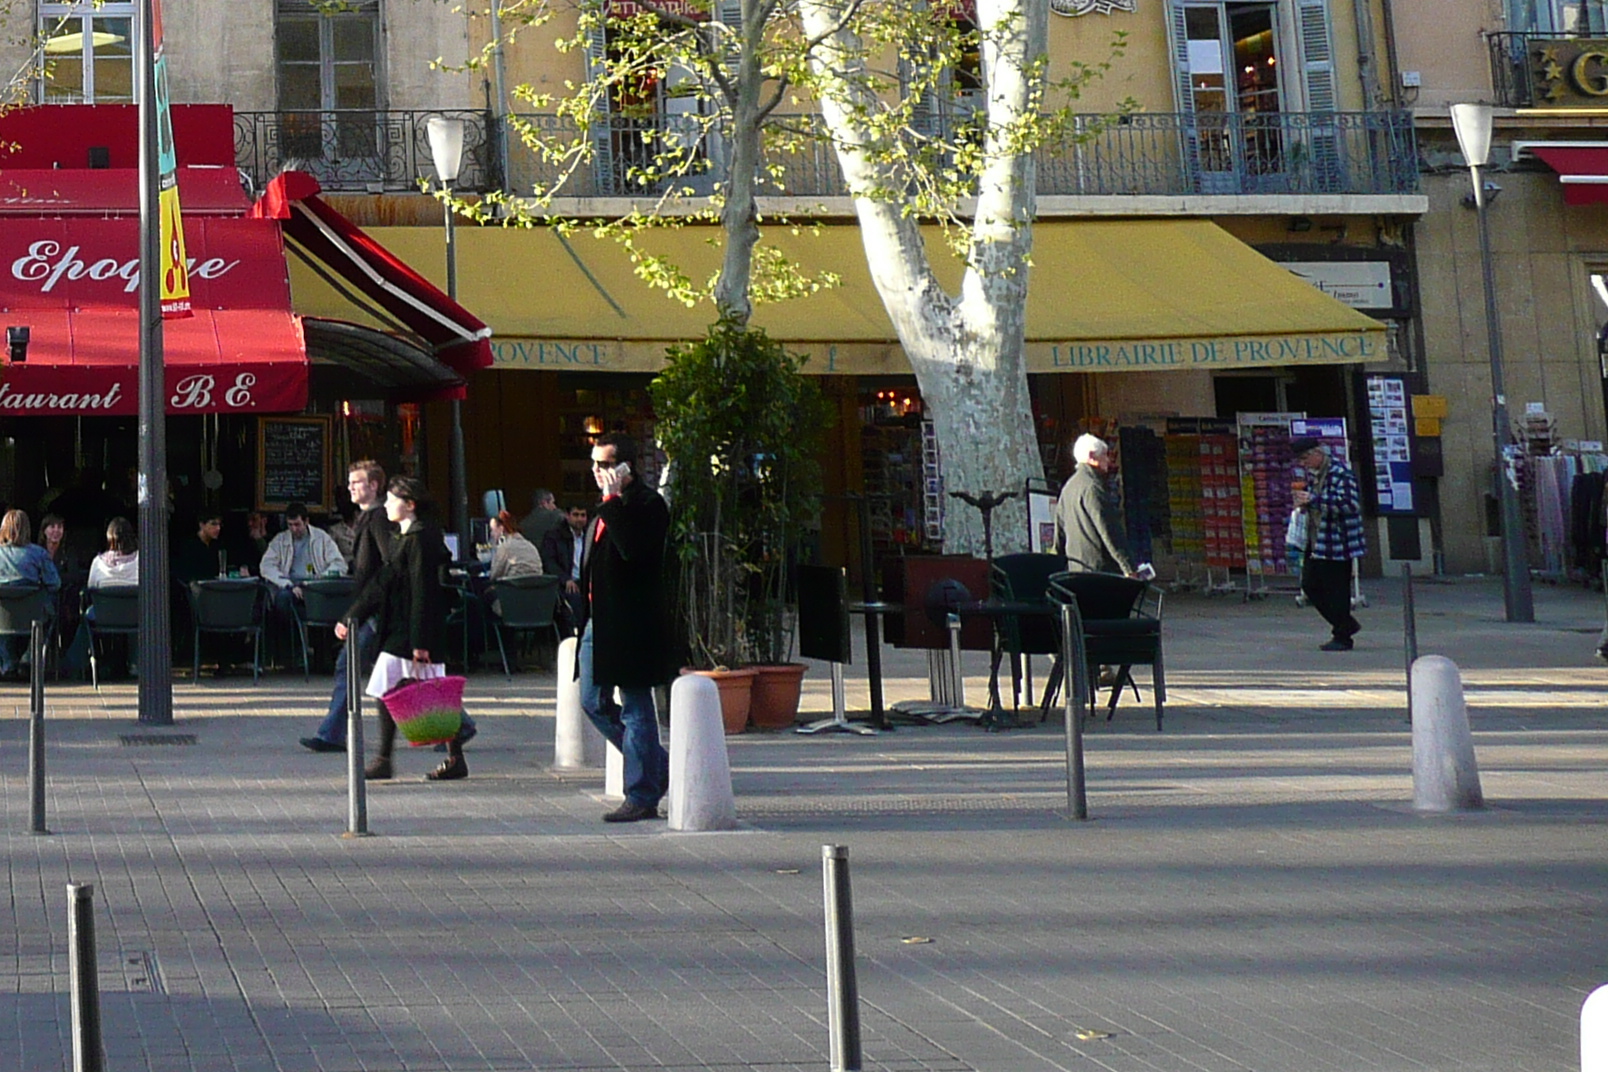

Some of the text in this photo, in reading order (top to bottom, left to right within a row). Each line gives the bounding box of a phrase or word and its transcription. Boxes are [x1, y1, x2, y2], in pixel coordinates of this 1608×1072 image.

[11, 240, 240, 292] Epoqe
[1051, 334, 1376, 367] LIBRAIRIE DE PROVENCE
[171, 374, 217, 408] B.
[224, 372, 257, 407] E.
